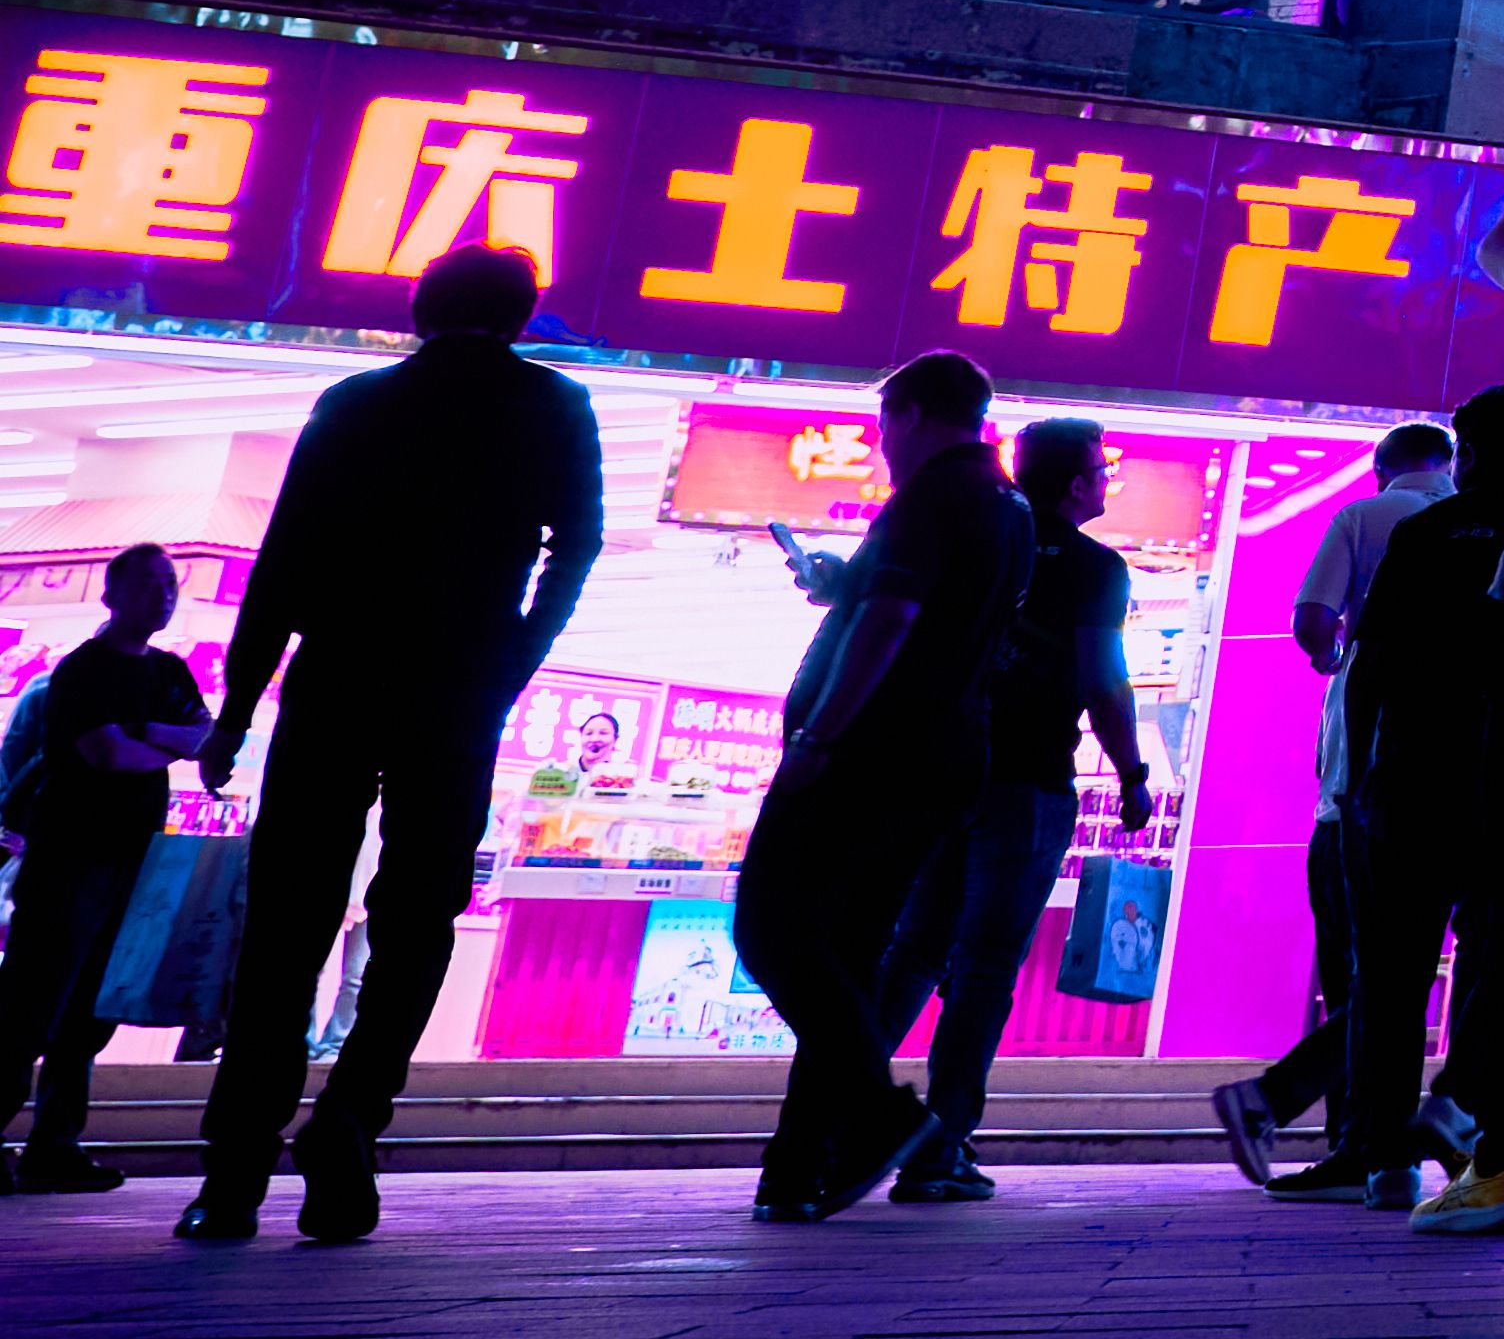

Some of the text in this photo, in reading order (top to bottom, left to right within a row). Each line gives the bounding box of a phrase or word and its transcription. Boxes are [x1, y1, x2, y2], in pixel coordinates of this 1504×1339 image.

[0, 48, 1417, 348] 重庆土特产
